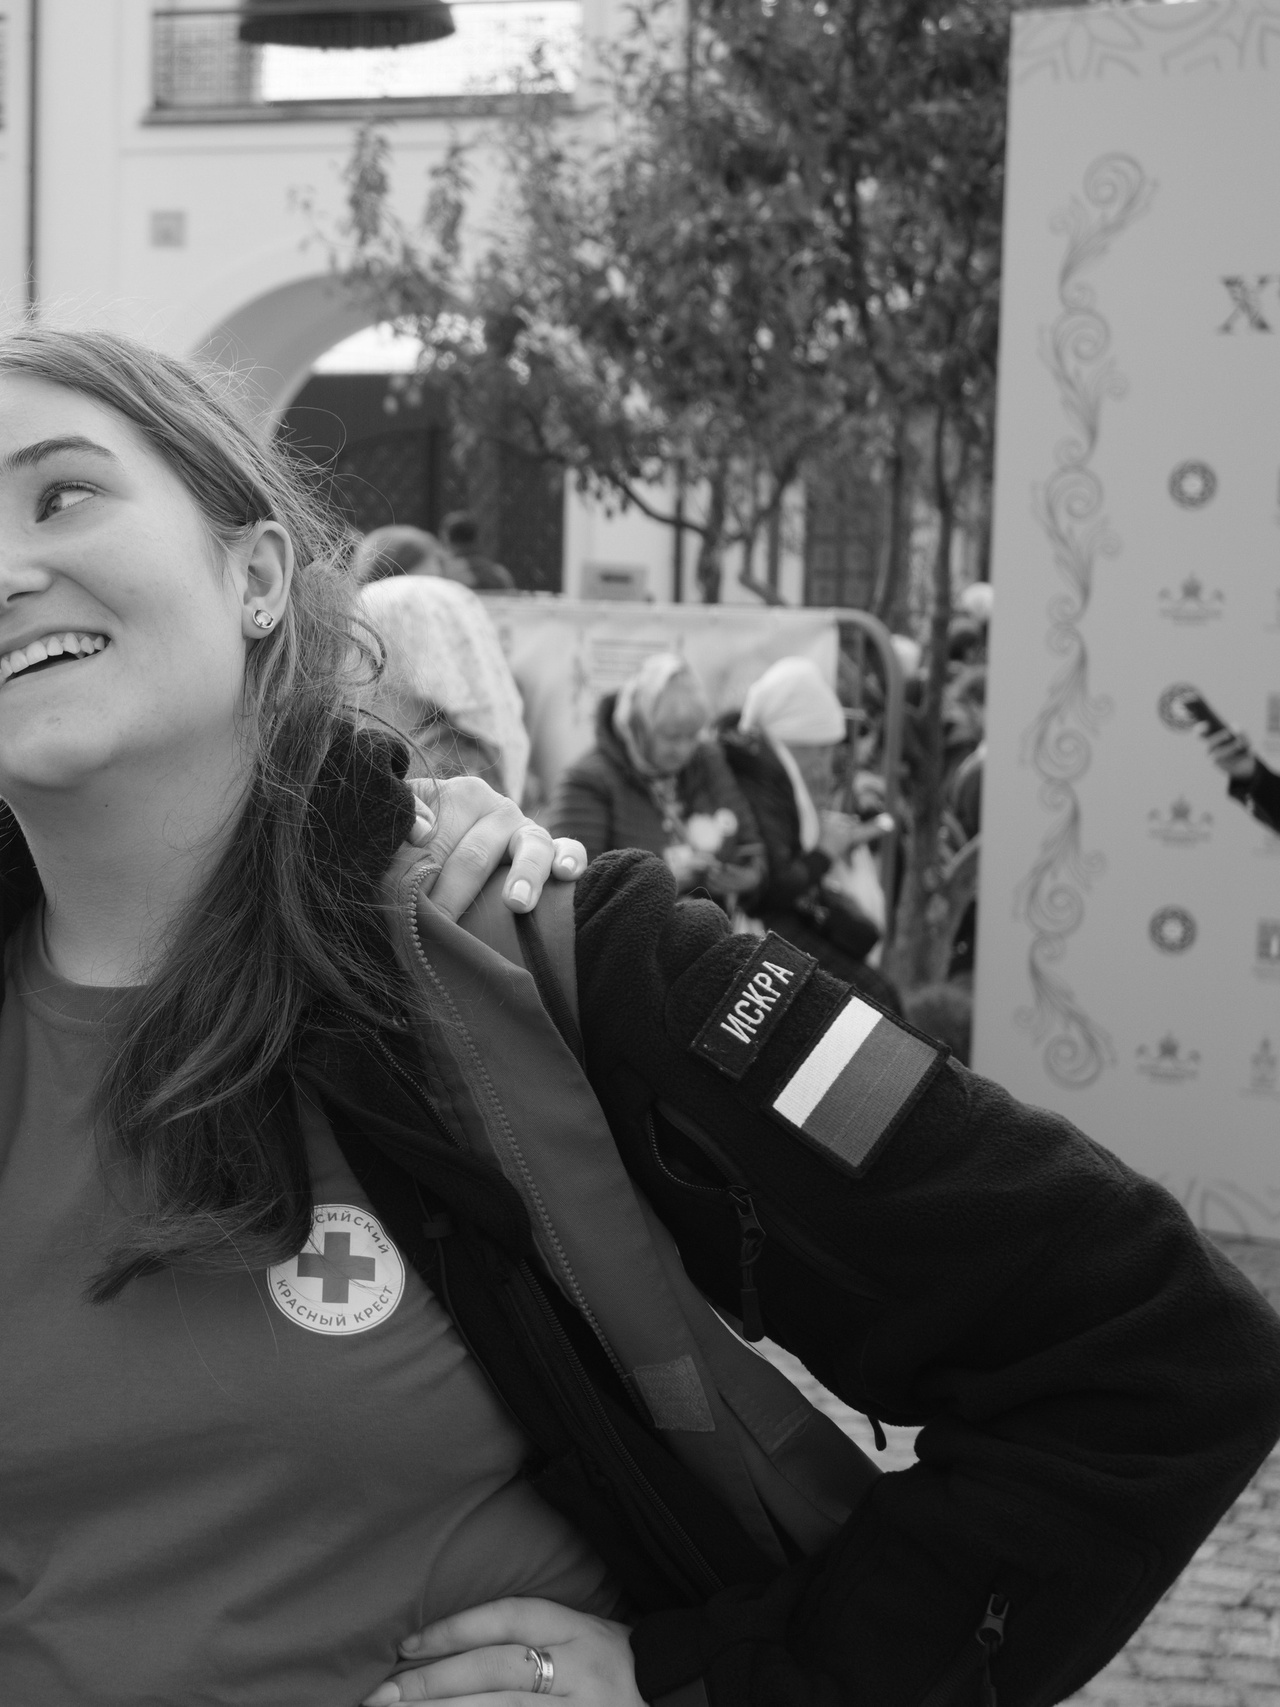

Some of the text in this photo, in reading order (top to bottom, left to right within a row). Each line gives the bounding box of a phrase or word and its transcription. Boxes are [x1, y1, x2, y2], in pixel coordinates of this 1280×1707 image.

[720, 960, 795, 1045] ИСКРА
[315, 1211, 391, 1255] СИЙСКИЙ
[276, 1279, 394, 1327] КРАСНЫЙ КРЕСТ
